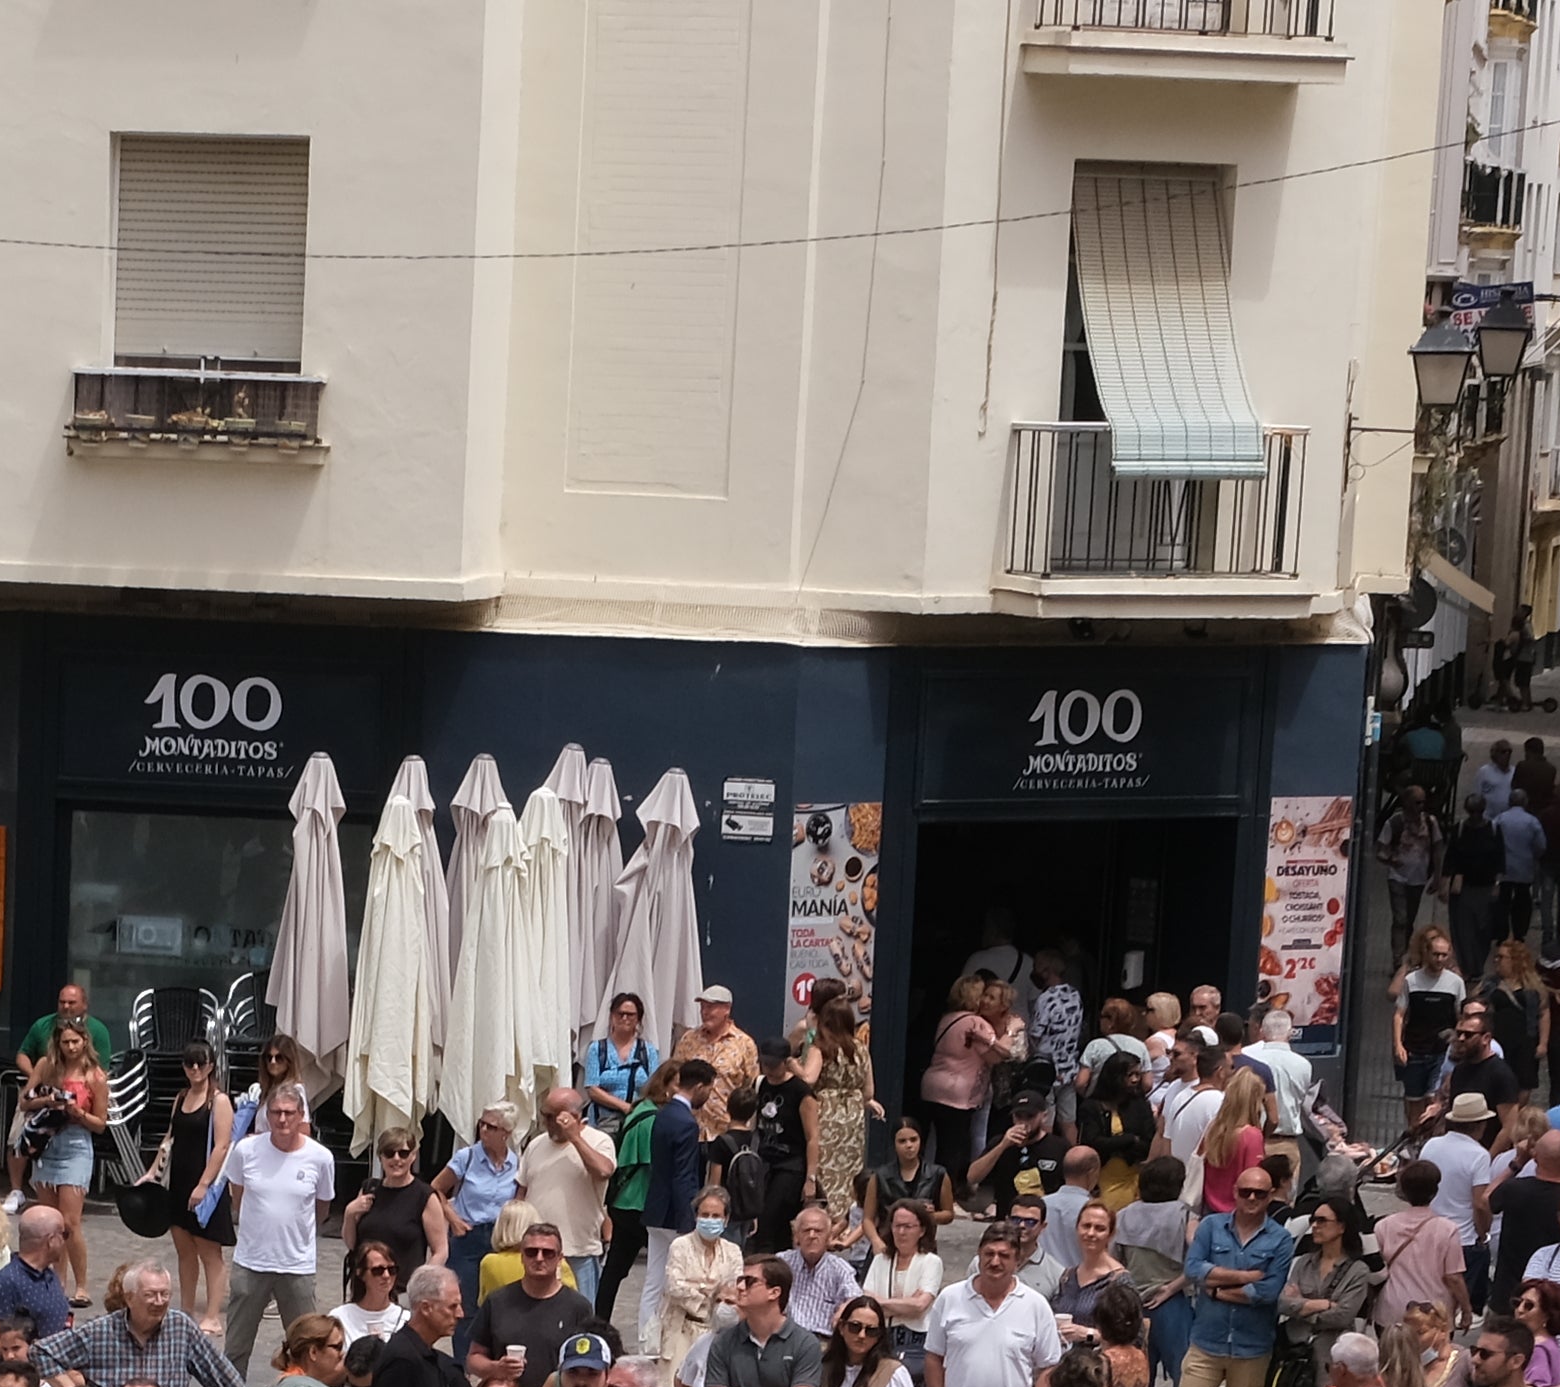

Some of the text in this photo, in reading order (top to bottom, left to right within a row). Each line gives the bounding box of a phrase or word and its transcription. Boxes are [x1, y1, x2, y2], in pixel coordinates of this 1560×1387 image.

[144, 672, 283, 732] 100
[1028, 688, 1143, 747] 100
[139, 734, 278, 760] MONTADITOS
[1022, 749, 1138, 776] MONTADITOS
[1276, 864, 1338, 877] DESAYUNO
[791, 894, 849, 918] MANÍA
[791, 928, 815, 938] TODA
